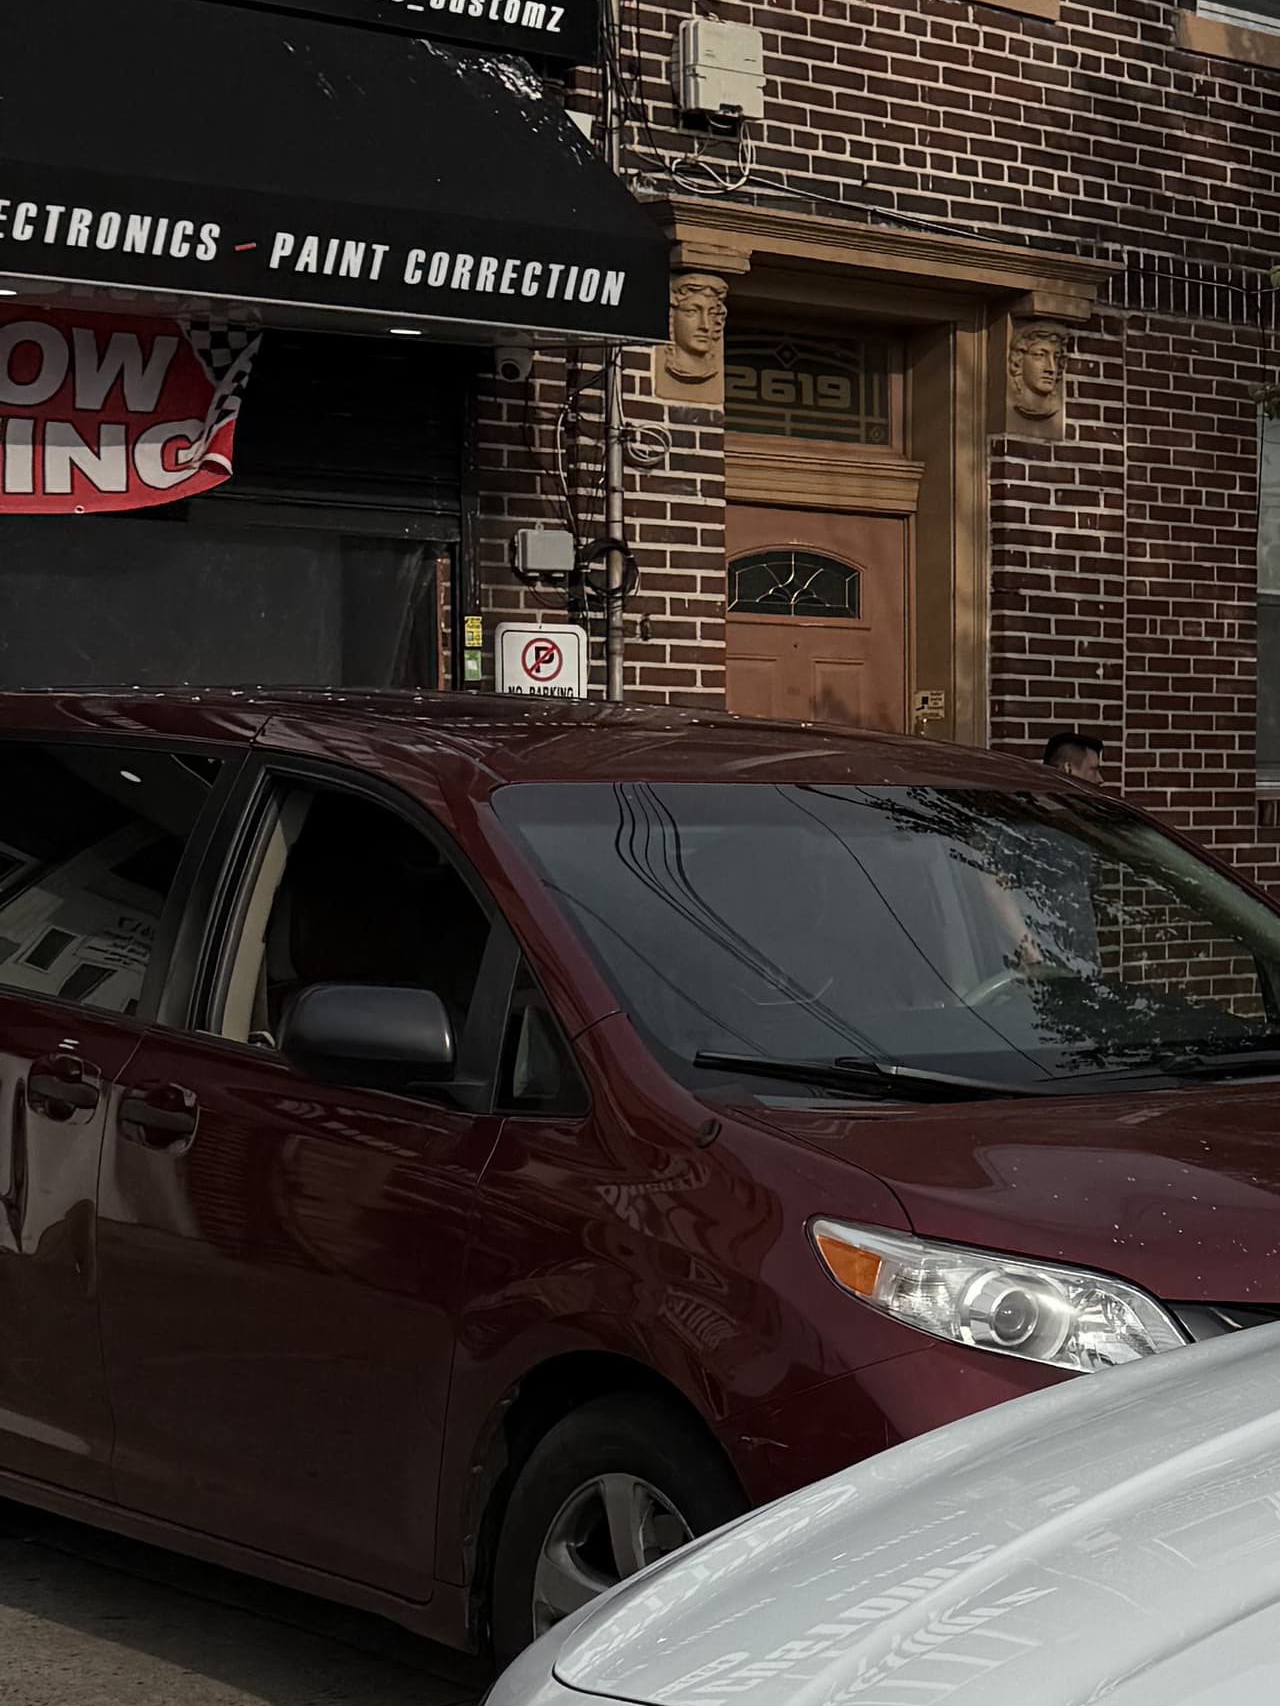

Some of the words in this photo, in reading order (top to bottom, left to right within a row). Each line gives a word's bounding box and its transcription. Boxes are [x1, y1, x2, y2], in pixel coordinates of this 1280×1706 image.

[269, 232, 389, 280] PAINT
[403, 249, 625, 306] CORRECTION
[724, 365, 851, 409] 2619
